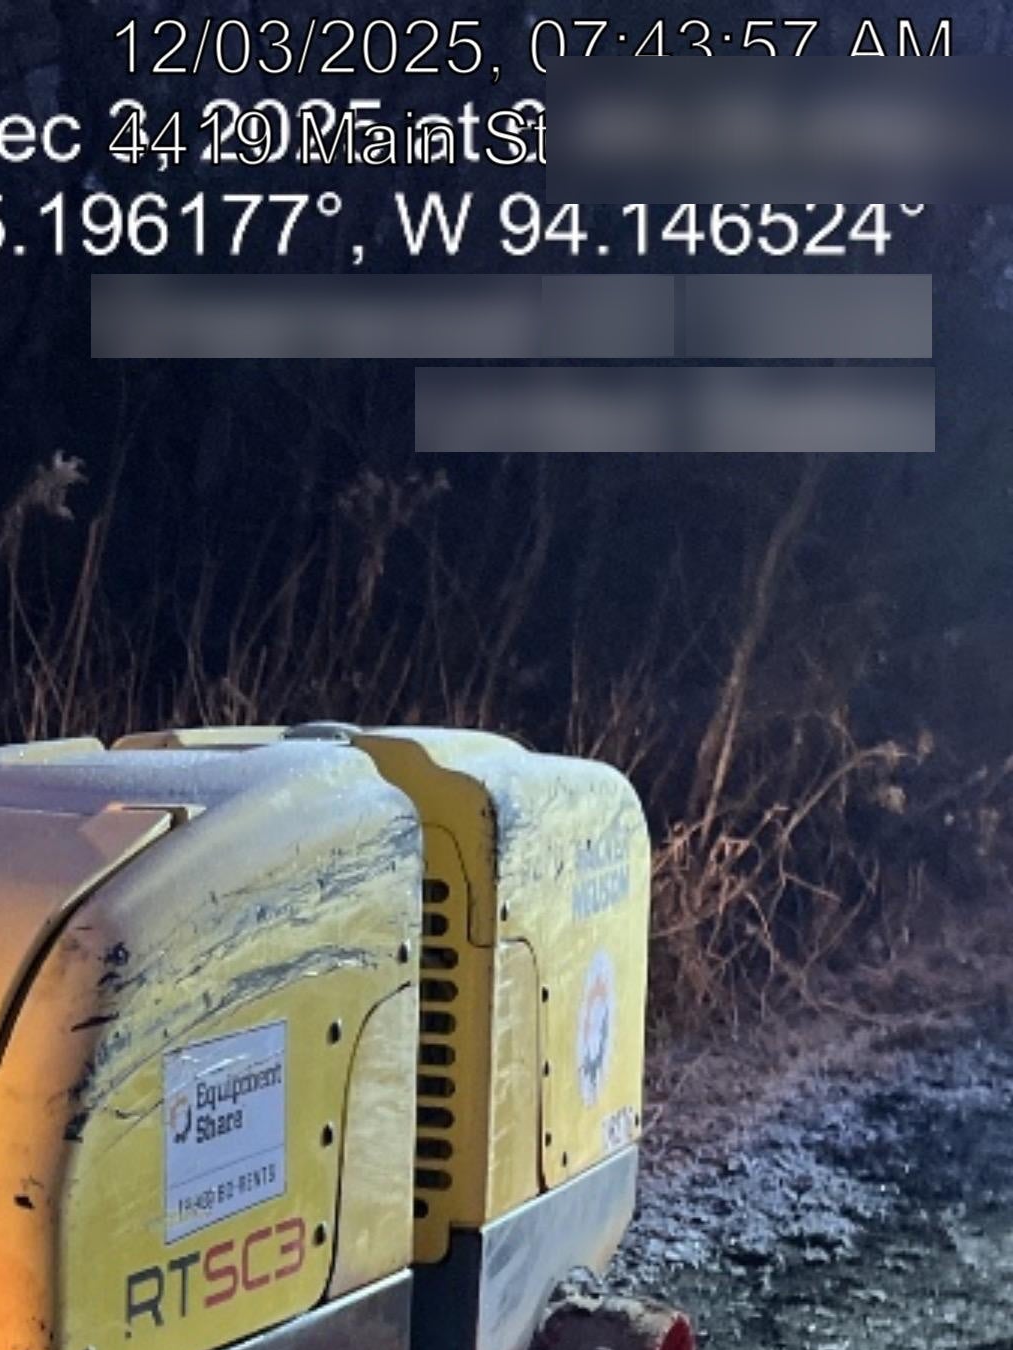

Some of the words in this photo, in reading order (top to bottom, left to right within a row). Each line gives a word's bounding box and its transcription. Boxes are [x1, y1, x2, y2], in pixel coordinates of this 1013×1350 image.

[195, 1062, 283, 1112] Equipment
[195, 1108, 244, 1144] Share
[125, 1216, 306, 1327] RTSC3
